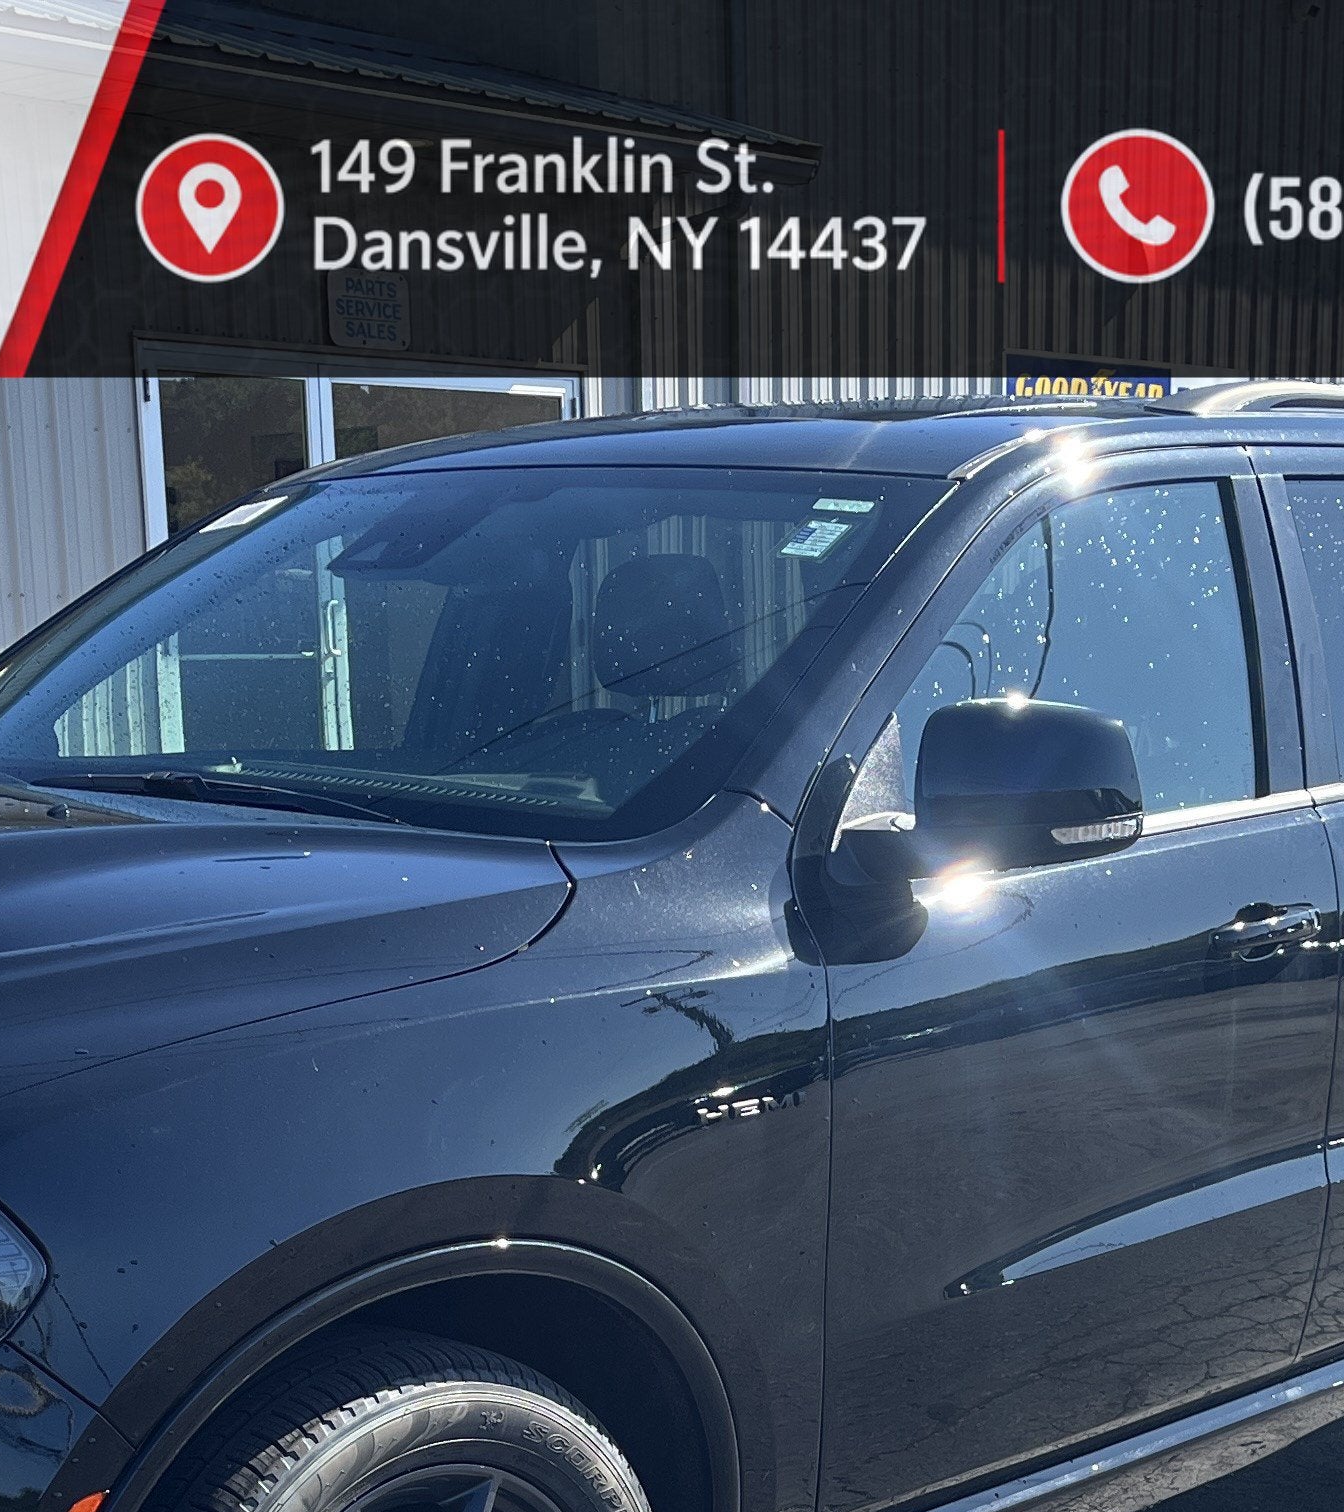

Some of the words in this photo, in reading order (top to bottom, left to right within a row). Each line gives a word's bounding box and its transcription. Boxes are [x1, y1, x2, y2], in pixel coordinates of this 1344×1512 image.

[345, 277, 397, 298] PARTS
[336, 298, 402, 320] SERVICE
[346, 321, 397, 342] SALES
